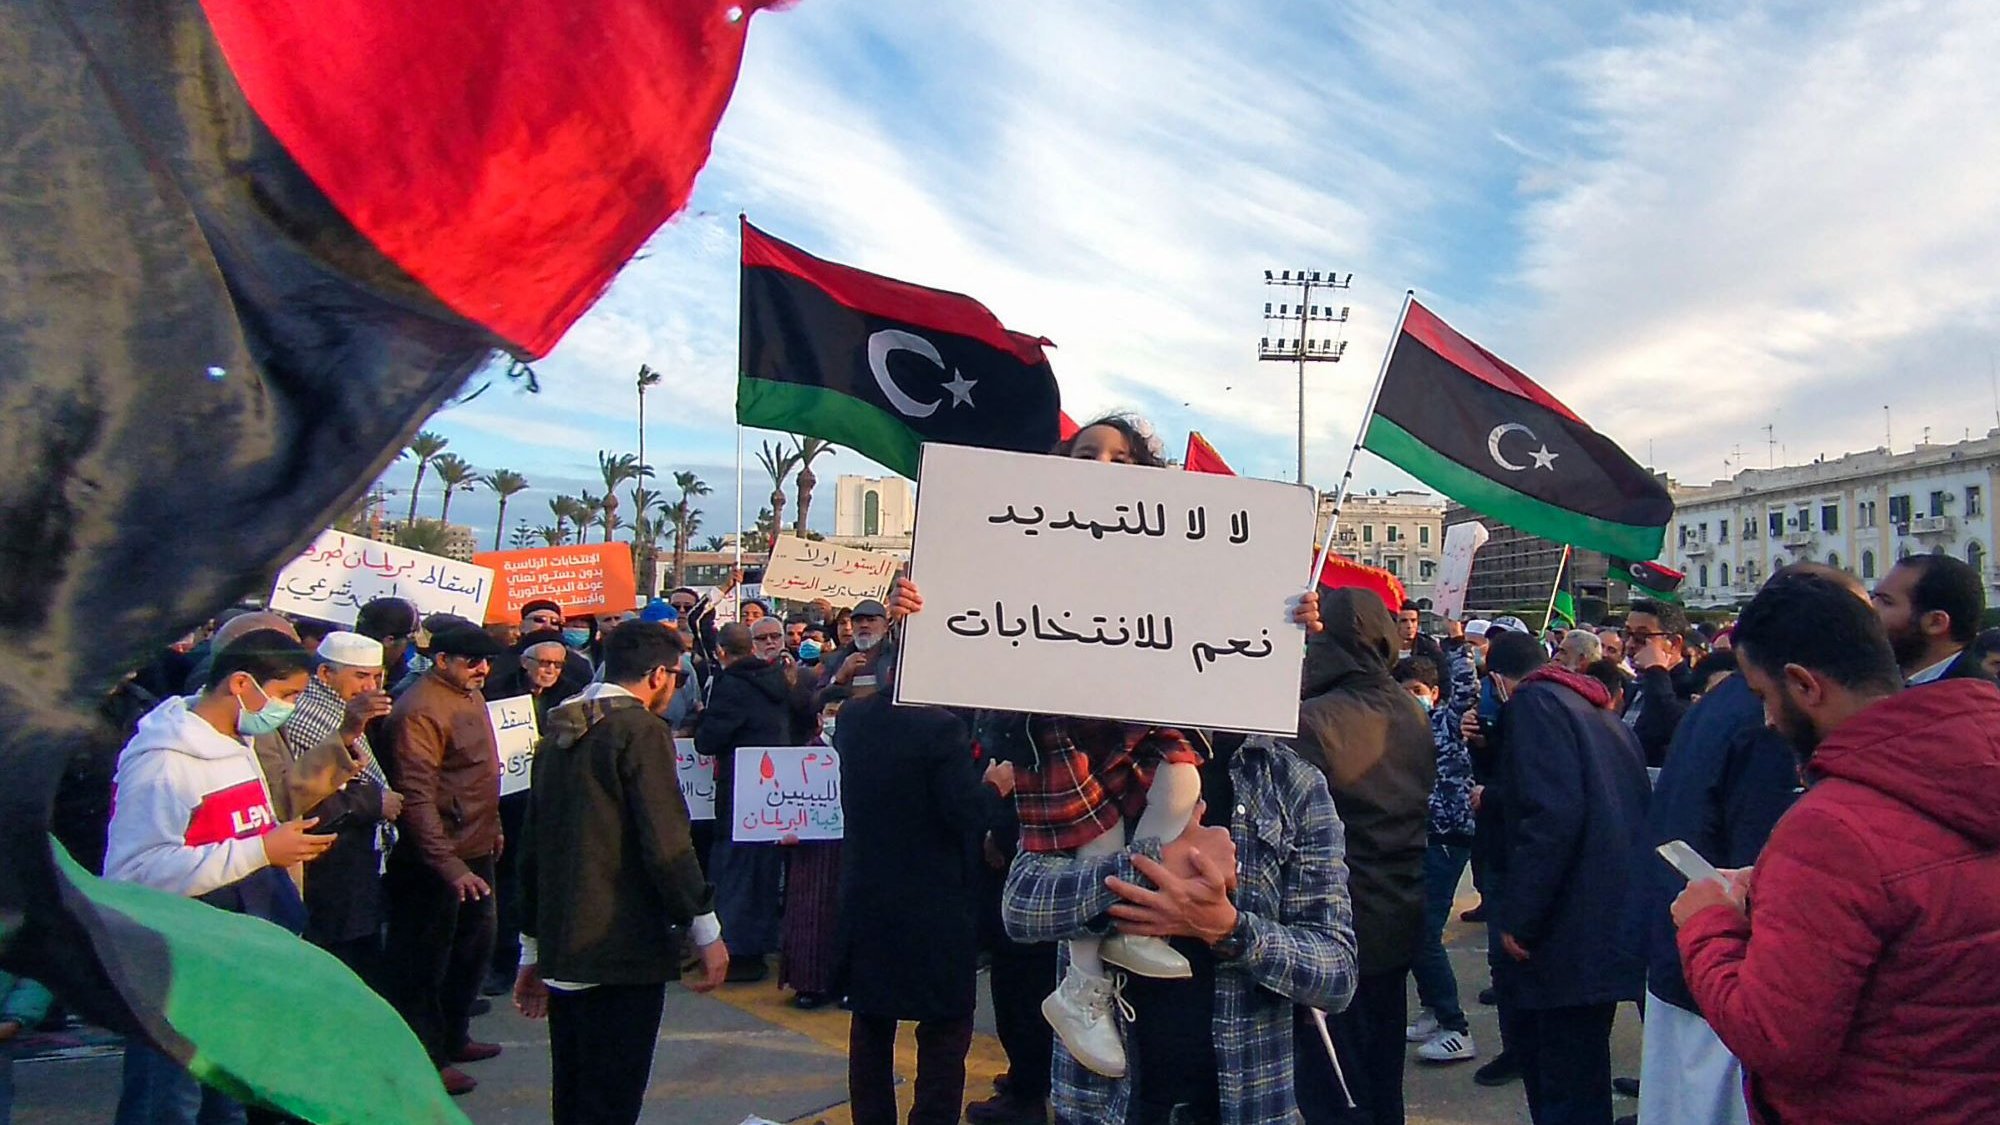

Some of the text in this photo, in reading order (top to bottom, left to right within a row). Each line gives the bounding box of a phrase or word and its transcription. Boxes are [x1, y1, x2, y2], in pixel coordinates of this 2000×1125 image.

[987, 500, 1249, 543] لا لا للتمديد
[342, 549, 416, 578] برلمان
[503, 557, 548, 573] الرئاسية
[833, 557, 892, 577] الدستور
[418, 564, 484, 603] اسقاط
[506, 569, 604, 587] بدون دستور تعني
[820, 584, 847, 598] يريد
[848, 584, 886, 602] الشعب
[946, 600, 1273, 673] نعم للانتخابات
[801, 752, 834, 784] دم
[743, 808, 808, 831] البرلمان
